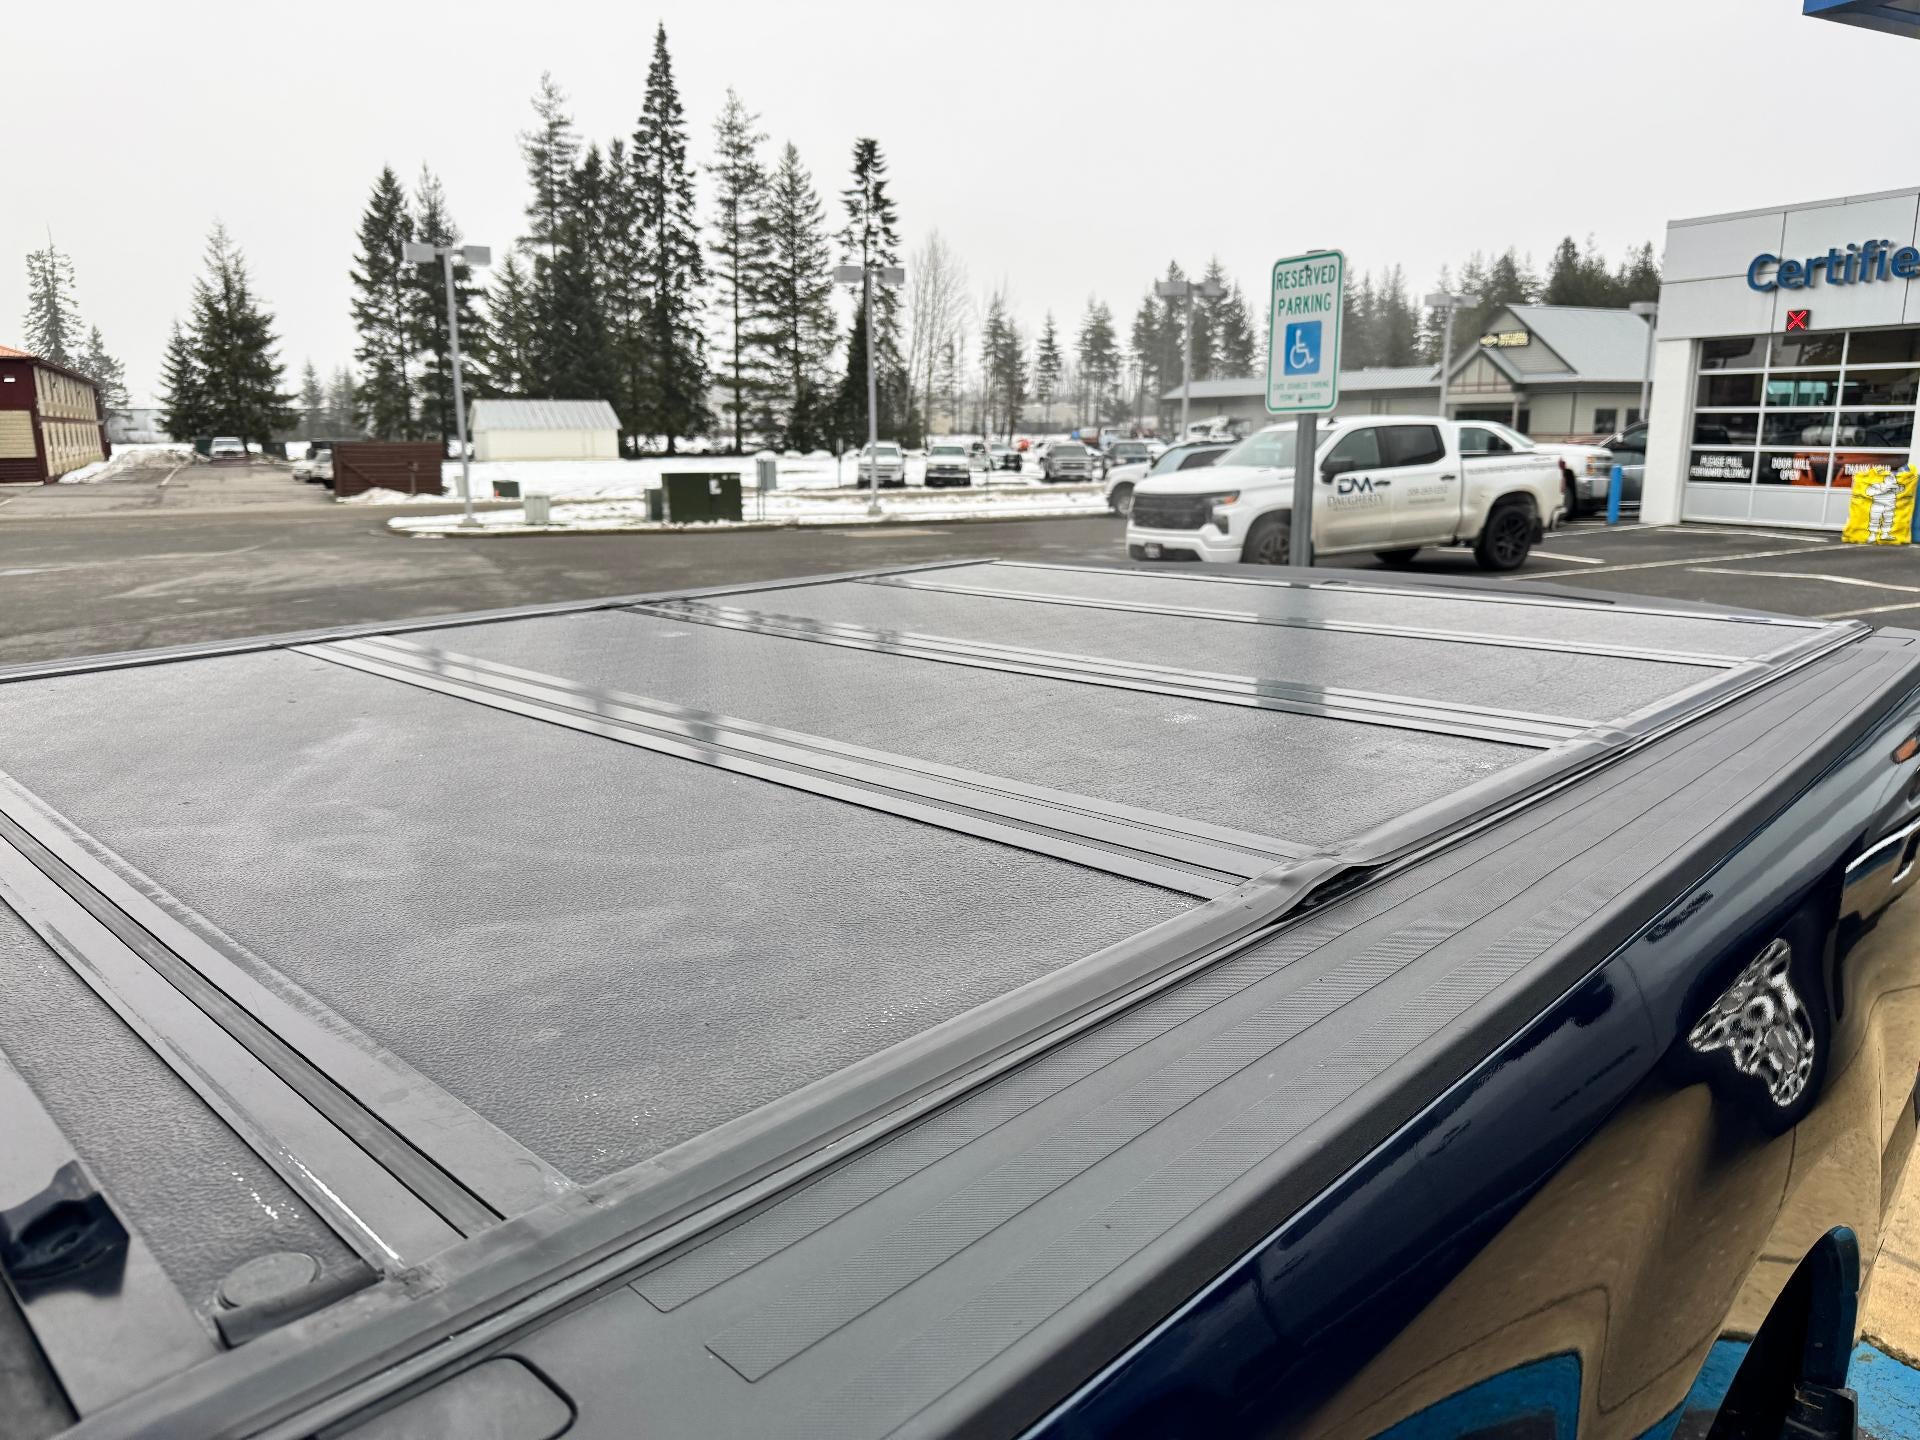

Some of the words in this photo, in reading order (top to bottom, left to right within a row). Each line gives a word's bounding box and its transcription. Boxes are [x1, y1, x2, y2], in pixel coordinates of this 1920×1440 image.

[1276, 264, 1336, 290] RESERVED
[1278, 292, 1331, 316] PARKING
[1772, 457, 1792, 469] DOOR
[1793, 458, 1811, 470] WILL
[1780, 469, 1801, 480] OPEN
